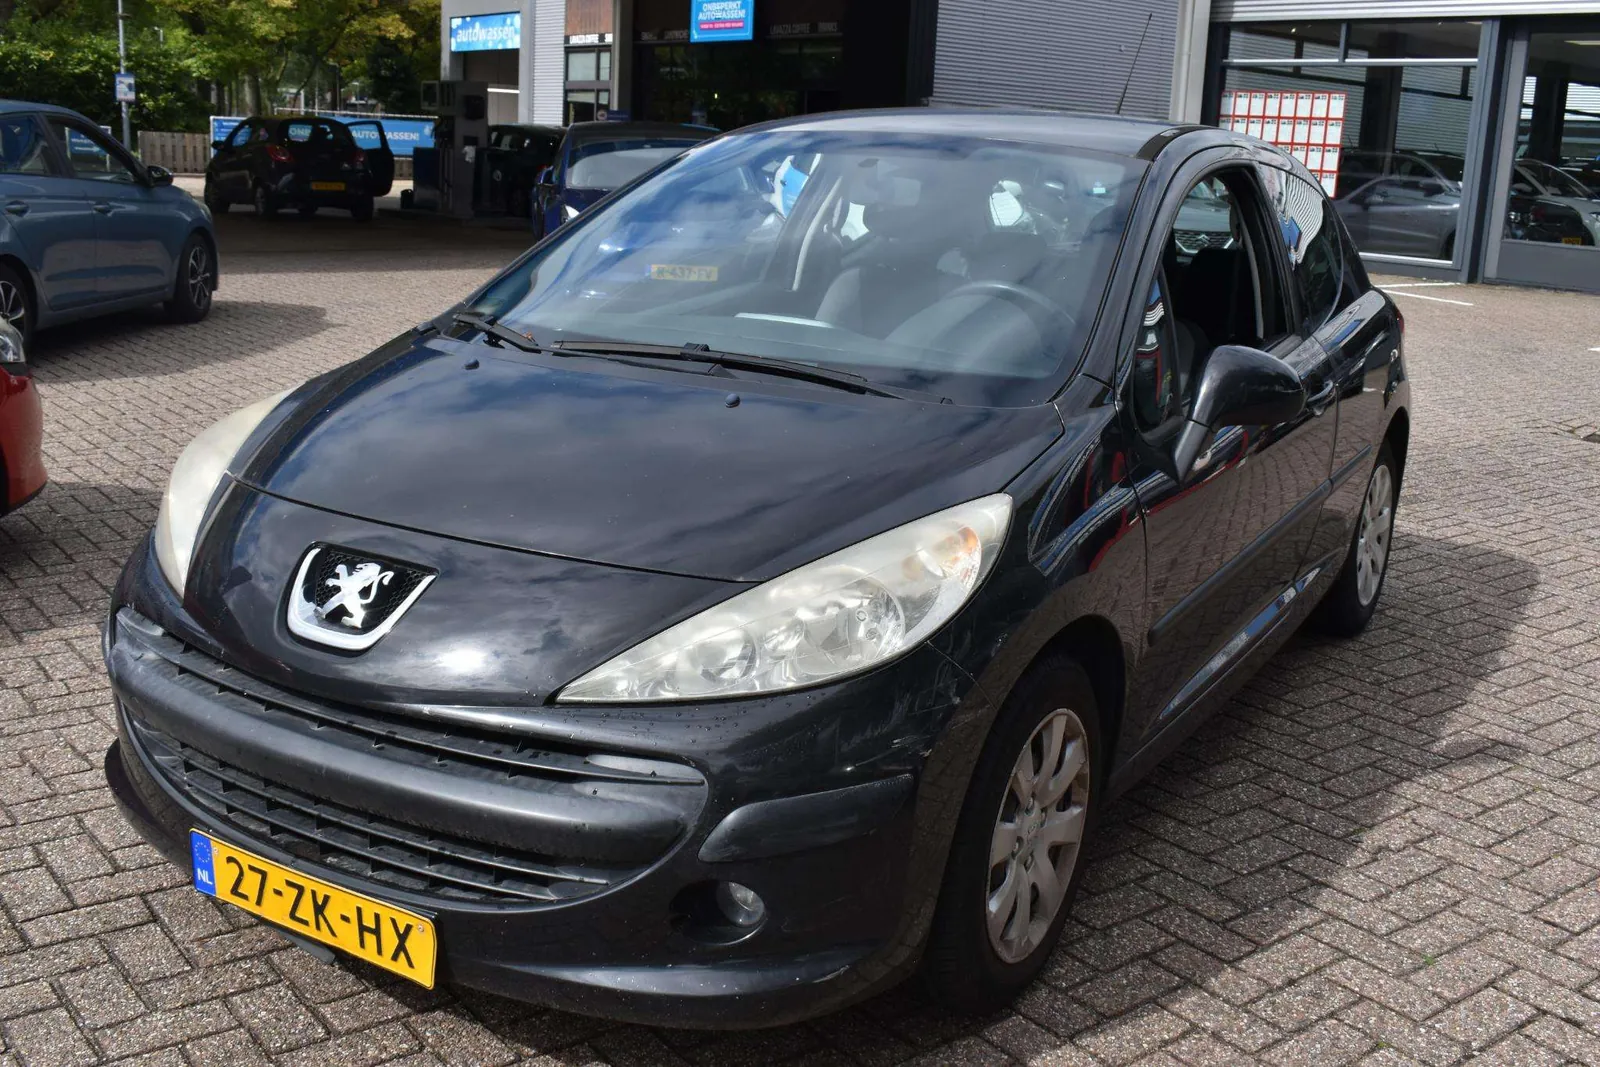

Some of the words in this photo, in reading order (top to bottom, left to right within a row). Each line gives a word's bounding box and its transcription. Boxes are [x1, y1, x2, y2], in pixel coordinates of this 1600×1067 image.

[456, 26, 515, 42] autowassen
[351, 129, 420, 141] AUTOASSEN!
[196, 867, 213, 886] NL
[226, 856, 415, 969] 27-ZK-HX
